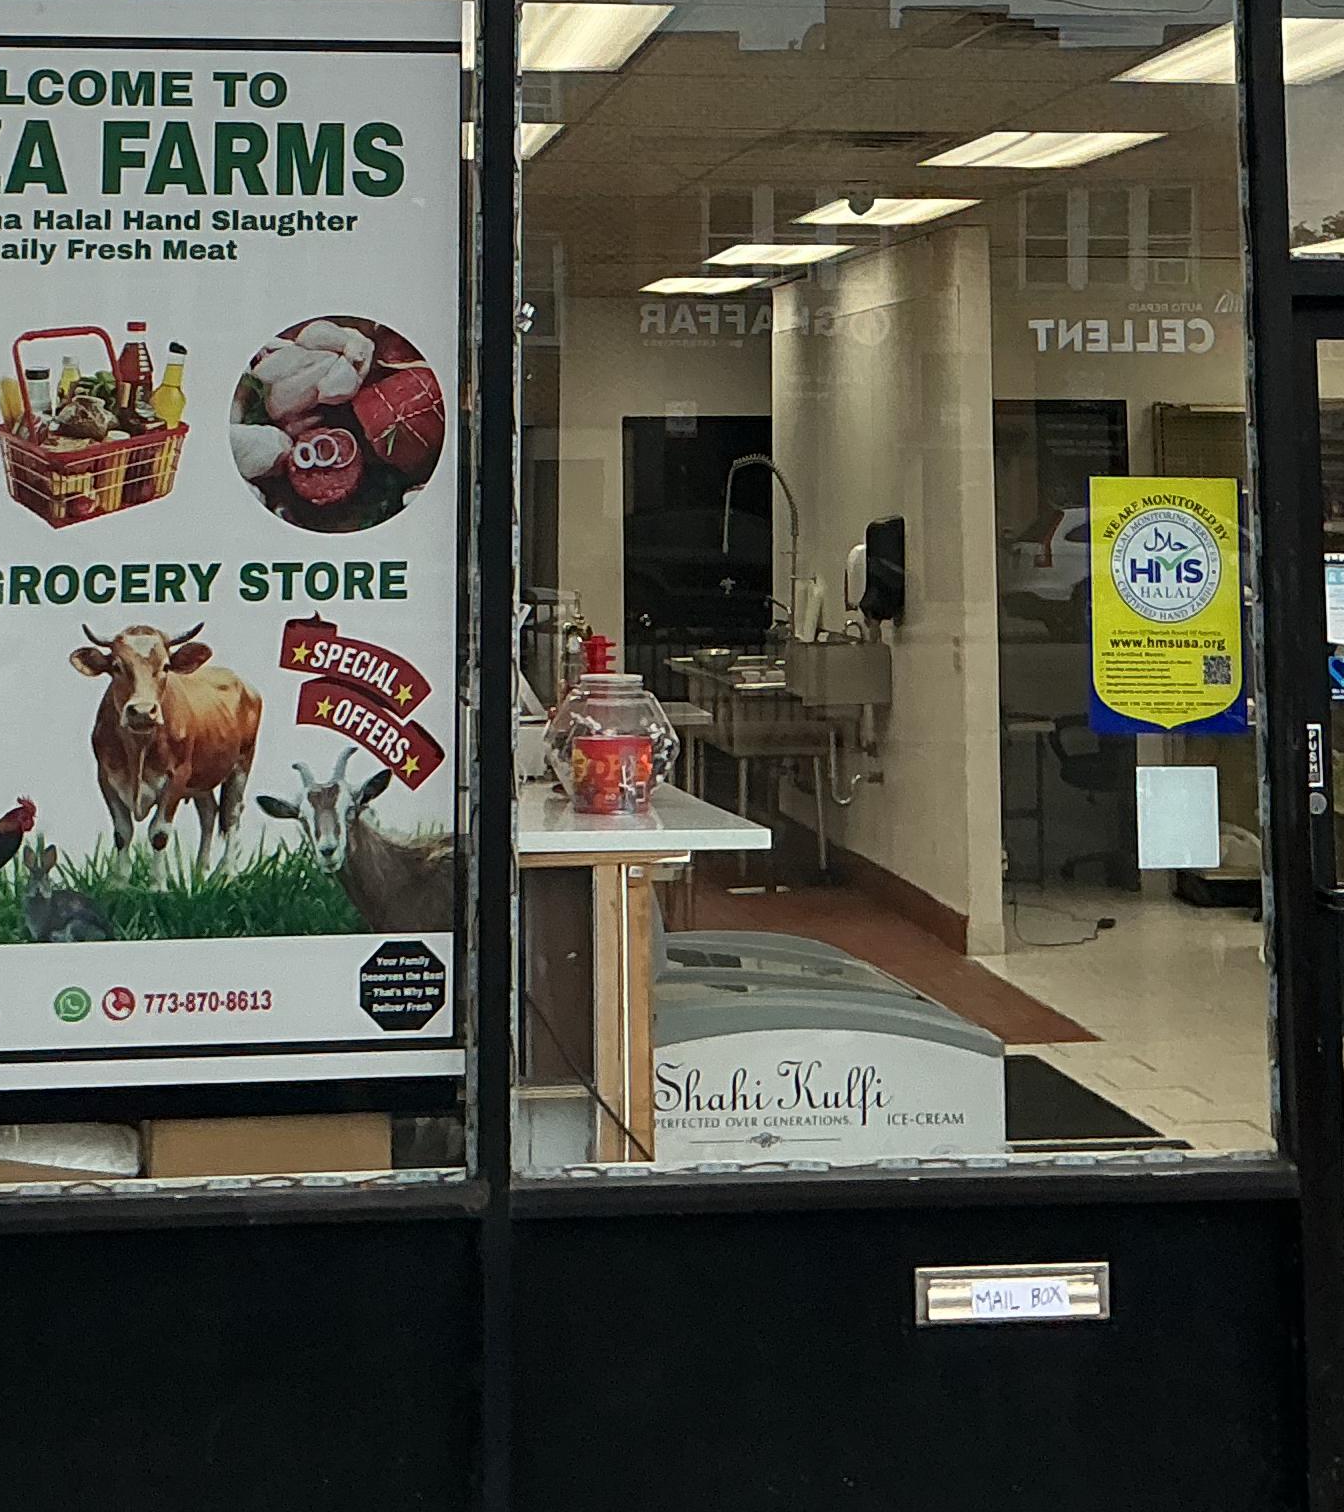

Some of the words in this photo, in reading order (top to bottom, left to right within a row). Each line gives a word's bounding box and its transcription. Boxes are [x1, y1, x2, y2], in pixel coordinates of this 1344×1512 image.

[212, 71, 288, 108] TO
[101, 120, 405, 198] FARMS
[33, 209, 112, 231] Halal
[123, 209, 202, 231] Hand
[211, 209, 359, 237] Slaughter
[67, 239, 152, 260] Fresh
[162, 240, 238, 261] Meat
[1103, 519, 1121, 541] WE
[1119, 500, 1139, 521] ARE
[1141, 493, 1217, 527] MONITORED
[1212, 522, 1230, 541] BY
[239, 560, 408, 602] STORE
[1129, 556, 1204, 584] HMS
[1139, 586, 1195, 600] HALAL
[1109, 636, 1226, 651] www.hmsusa.org
[309, 640, 399, 697] SPECIAL
[331, 699, 410, 764] OFFERS
[143, 989, 273, 1015] 773-870-8613
[654, 1061, 773, 1113] Shahi
[776, 1059, 894, 1127] Kulfi
[725, 1116, 759, 1128] OVER
[886, 1112, 965, 1126] ICE-CREAM
[975, 1289, 1021, 1313] MAIL
[1030, 1285, 1064, 1309] BOX
